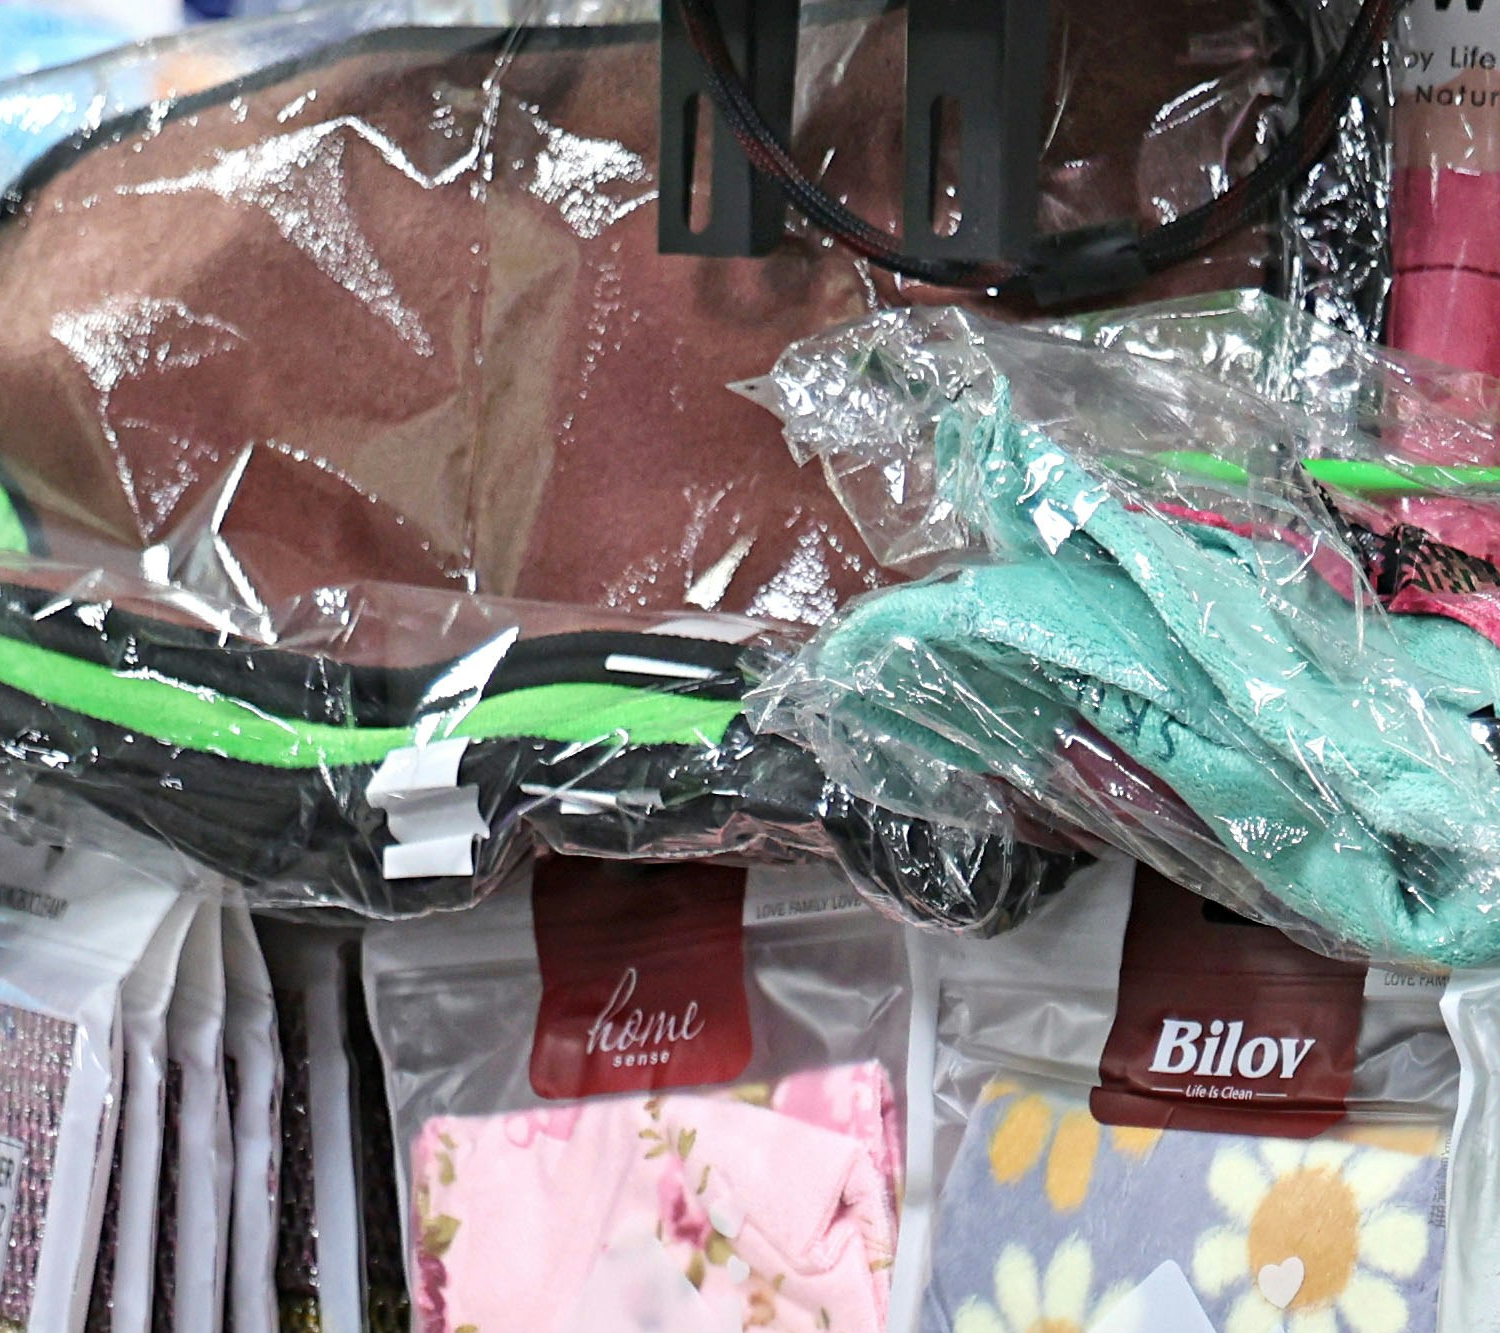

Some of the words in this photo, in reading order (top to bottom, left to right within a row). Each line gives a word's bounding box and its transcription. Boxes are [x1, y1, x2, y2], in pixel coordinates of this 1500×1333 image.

[1451, 47, 1496, 69] Life
[586, 967, 705, 1055] home
[612, 1051, 671, 1069] sense
[1185, 1084, 1208, 1098] Life
[1220, 1086, 1254, 1101] Clean
